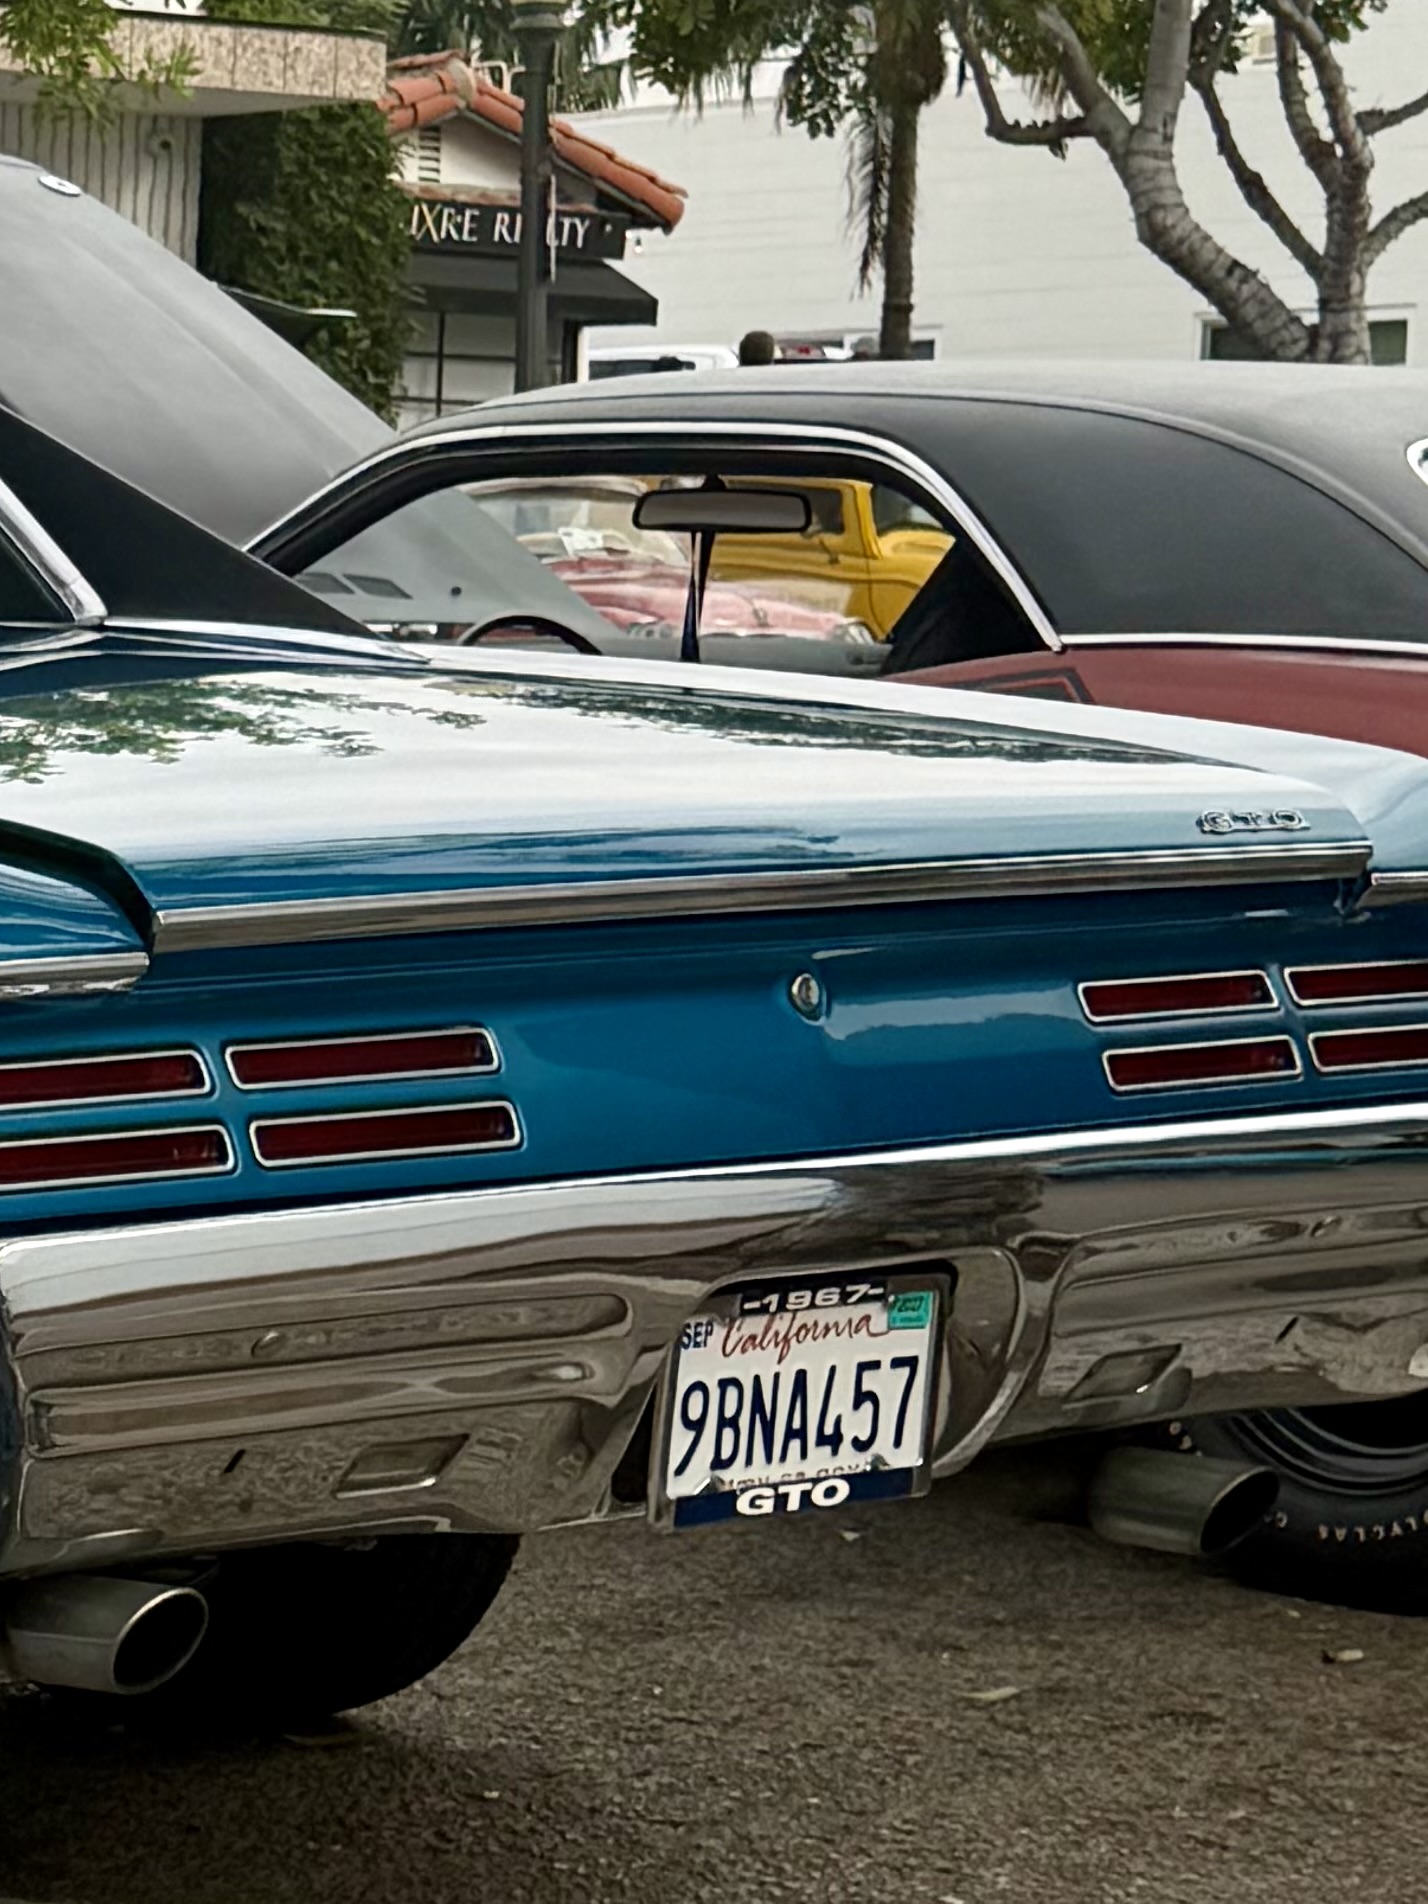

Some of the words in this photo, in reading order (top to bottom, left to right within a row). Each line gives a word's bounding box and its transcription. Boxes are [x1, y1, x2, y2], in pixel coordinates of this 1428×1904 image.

[493, 212, 590, 249] RLTY
[1199, 808, 1306, 834] GTO
[680, 1319, 715, 1350] SEP
[720, 1312, 890, 1364] California
[673, 1354, 920, 1478] 9BNA457
[735, 1478, 851, 1516] GTO
